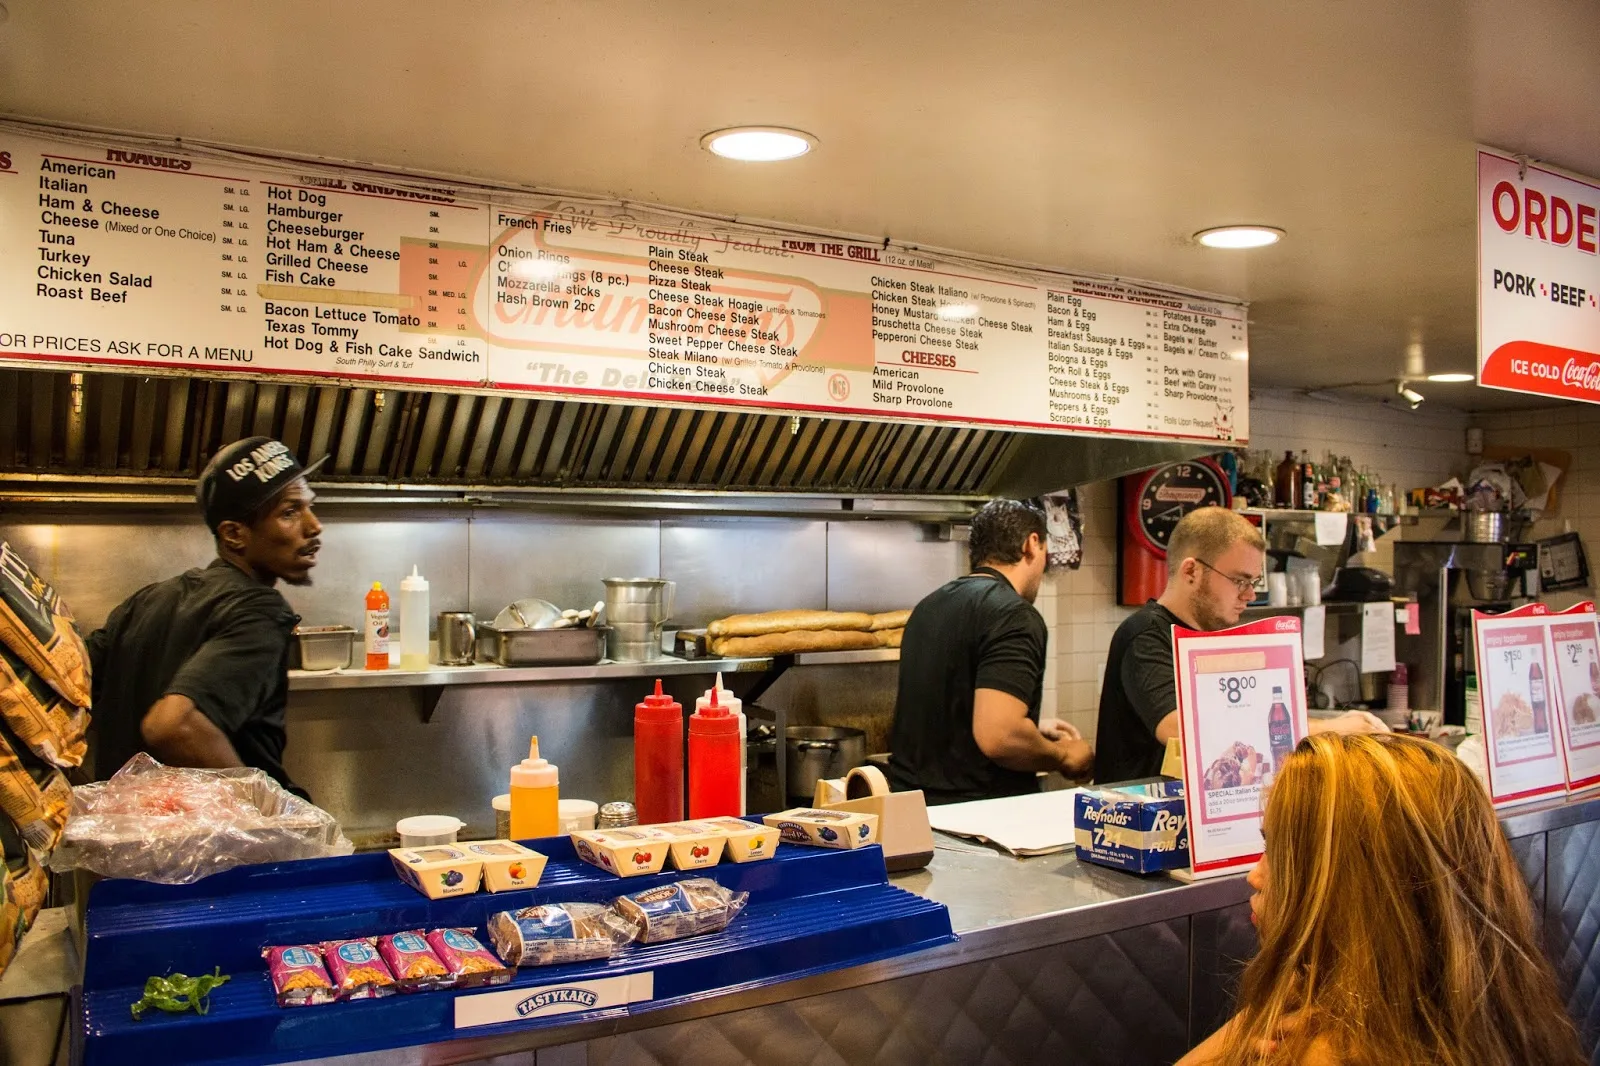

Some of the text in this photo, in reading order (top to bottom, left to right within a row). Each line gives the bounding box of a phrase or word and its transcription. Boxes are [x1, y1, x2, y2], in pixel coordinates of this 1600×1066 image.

[41, 159, 115, 179] American
[107, 149, 192, 170] HOAGIES
[39, 176, 88, 194] Italian
[268, 187, 326, 206] Hot Dog
[39, 194, 160, 219] Ham & Cheese
[267, 203, 343, 223] Hamburger
[498, 215, 572, 234] French Fries
[1492, 180, 1600, 254] ORDE
[41, 212, 216, 243] Cheese (Mixed or One Choice)
[267, 220, 364, 241] Cheeseburger
[39, 230, 75, 245] Tuna
[38, 248, 90, 266] Turkey
[266, 236, 400, 261] Hot Ham & Cheese
[498, 245, 570, 264] Onion Rings
[649, 246, 708, 263] Plain Steak
[781, 240, 816, 253] FROM
[820, 243, 843, 256] THE
[847, 244, 881, 262] GRILL
[885, 256, 896, 265] (12
[37, 266, 152, 288] Chicken Salad
[265, 270, 335, 287] Fish Cake
[497, 276, 600, 297] Mozzarella sticks
[591, 270, 603, 283] (8
[608, 275, 629, 287] pc.)
[37, 284, 128, 303] Roast Beef
[871, 276, 968, 298] Chicken Steak Italiano
[1494, 269, 1585, 307] PORK BEEF
[497, 292, 595, 312] Hash Brown 2pc
[649, 290, 688, 305] Cheese
[694, 295, 724, 308] Steak
[728, 298, 763, 312] Hoagie
[265, 303, 420, 326] Bacon Lettuce Tomato
[872, 303, 899, 317] Honey
[903, 307, 938, 320] Mustard
[978, 317, 1008, 329] Cheese
[1011, 322, 1033, 333] Steak
[1047, 304, 1071, 315] Bacon
[1082, 309, 1096, 320] Egg
[1163, 310, 1191, 322] Potatoes
[1201, 316, 1217, 327] Eggs
[265, 319, 359, 339] Texas Tommy
[1163, 322, 1206, 335] Extra Cheese
[649, 334, 798, 357] Sweet Pepper Cheese Steak
[1048, 328, 1083, 340] Breakfast
[1087, 333, 1117, 346] Sausage
[1128, 338, 1145, 349] Eggs
[33, 336, 101, 352] PRICES
[107, 342, 141, 355] ASK
[147, 344, 182, 358] FOR
[188, 347, 202, 359] A
[205, 348, 253, 362] MENU
[648, 348, 718, 364] Steak Milano
[902, 350, 956, 367] CHEESES
[336, 357, 356, 365] South
[358, 358, 377, 367] Philly
[1511, 359, 1529, 375] ICE
[1531, 362, 1559, 379] COLD
[873, 366, 919, 379] American
[1164, 366, 1216, 381] Pork with Gravy
[872, 380, 944, 394] Mild Provolone
[1049, 389, 1091, 400] Mushrooms
[1102, 393, 1120, 404] Eggs
[1164, 389, 1218, 403] Sharp Provolone
[1050, 413, 1082, 425] Scrapple
[1093, 415, 1111, 426] Eggs
[225, 458, 255, 481] LOS
[1176, 466, 1190, 477] 12
[1143, 499, 1151, 510] 9
[1083, 806, 1128, 825] Reynolds
[1093, 828, 1122, 848] 724
[1149, 840, 1176, 853] FOIL
[518, 990, 595, 1014] TASTYKAKE
